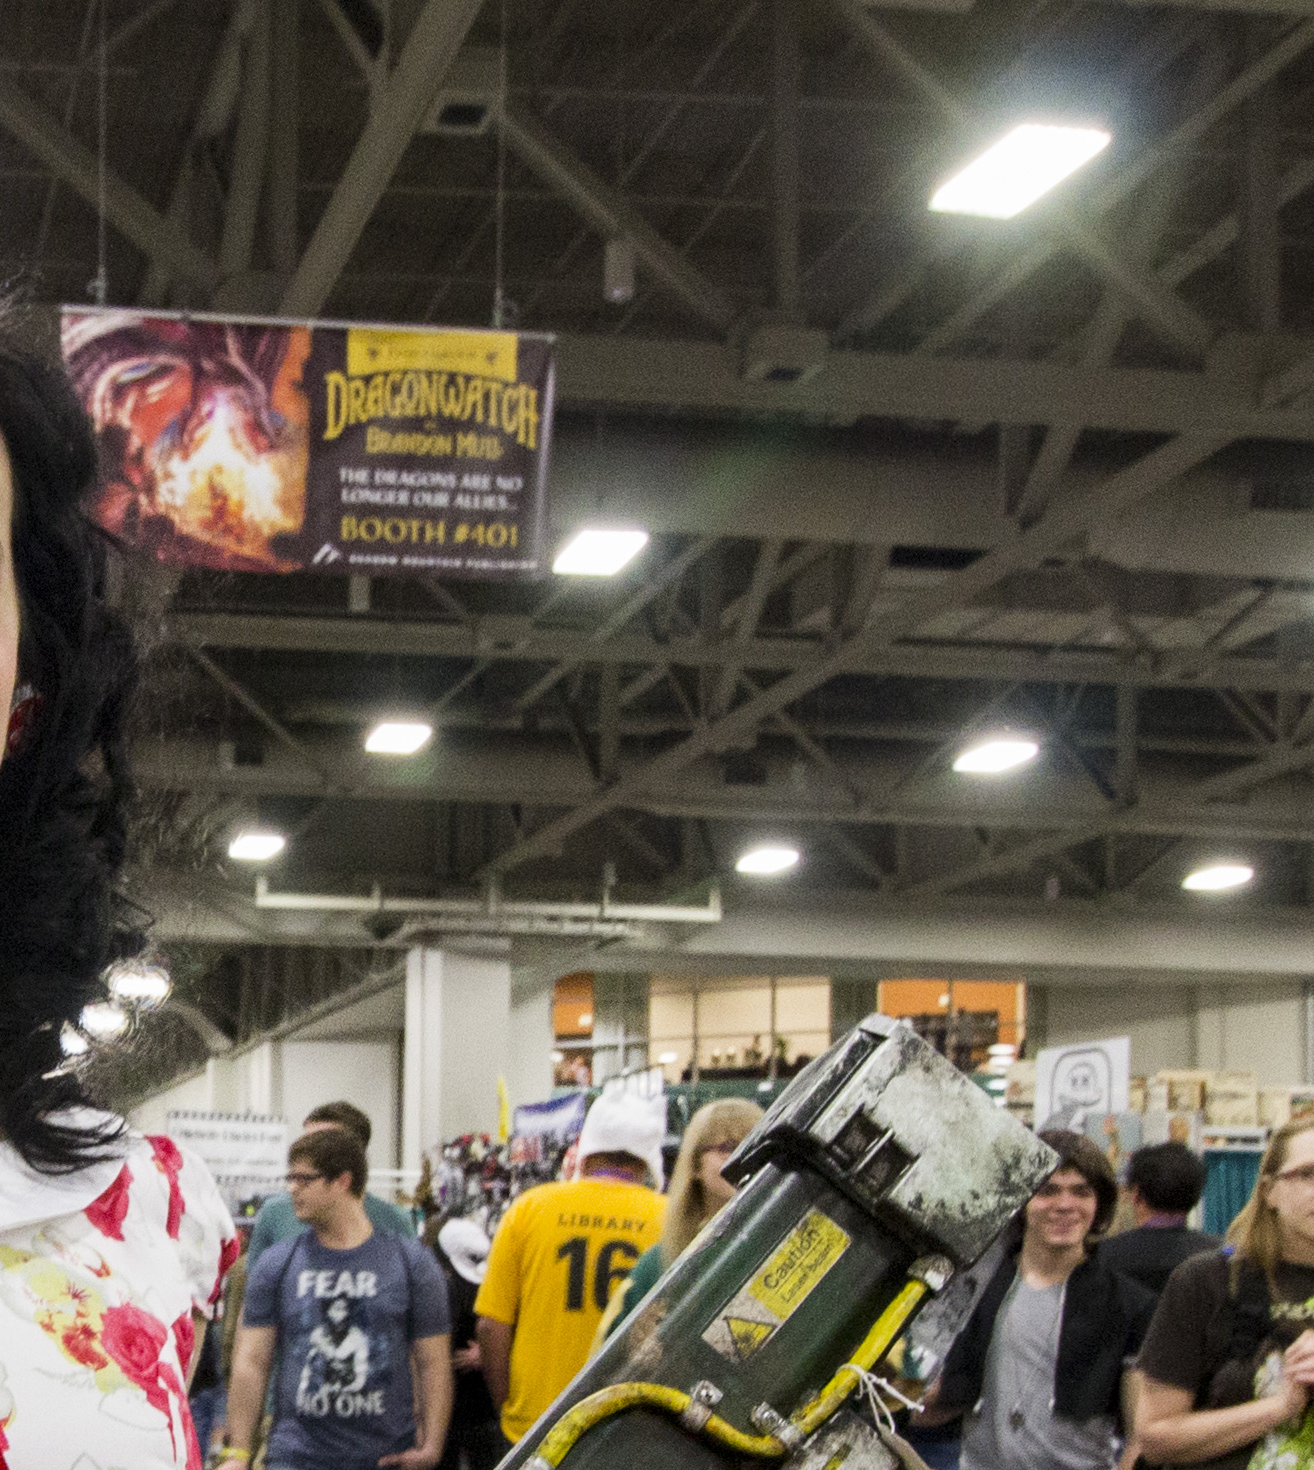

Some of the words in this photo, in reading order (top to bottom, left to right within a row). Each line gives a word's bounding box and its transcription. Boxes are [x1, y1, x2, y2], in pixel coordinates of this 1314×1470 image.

[323, 369, 540, 449] DRAGONWATCH
[339, 466, 371, 486] THE
[373, 467, 457, 489] DRAGONS
[460, 471, 492, 491] ARE
[495, 474, 524, 492] NO
[341, 486, 411, 506] LONGER
[412, 491, 450, 508] OUR
[340, 515, 447, 545] BOOTH
[453, 521, 519, 549] #401
[557, 1212, 647, 1233] LIBRARY
[555, 1235, 640, 1314] 16
[763, 1228, 821, 1290] Caution
[296, 1267, 378, 1299] FEAR
[296, 1391, 330, 1418] NO
[334, 1388, 388, 1419] ONE
